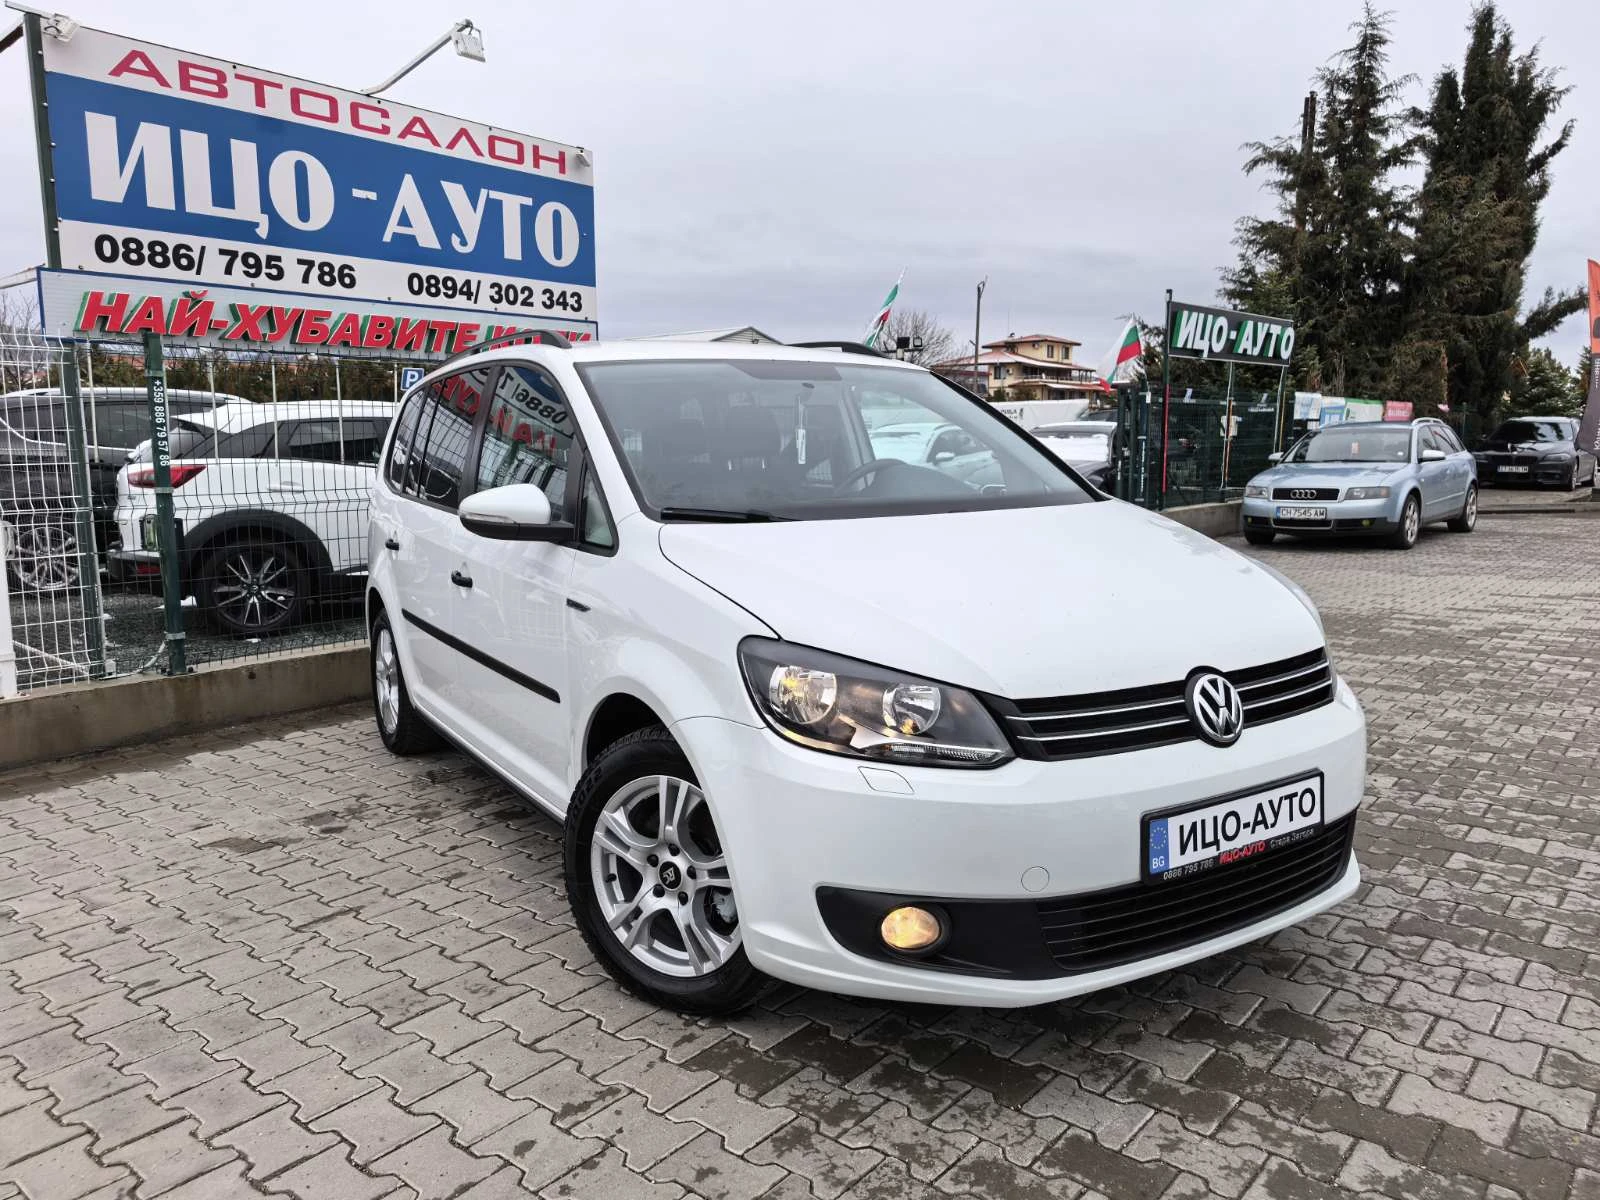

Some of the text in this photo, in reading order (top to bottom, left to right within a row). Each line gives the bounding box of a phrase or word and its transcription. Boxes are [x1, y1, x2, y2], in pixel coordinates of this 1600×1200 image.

[108, 49, 567, 176] АВТОСАЛОН
[94, 233, 357, 289] 0886/ 795 786
[77, 289, 481, 353] НАЙ-ХУБАВИТЕ
[407, 272, 583, 313] 0894/ 302 343
[406, 371, 420, 387] P
[153, 379, 170, 467] +359 886 79 57 86
[1179, 788, 1316, 856] ИЦО-АУТО
[1152, 856, 1166, 869] BG
